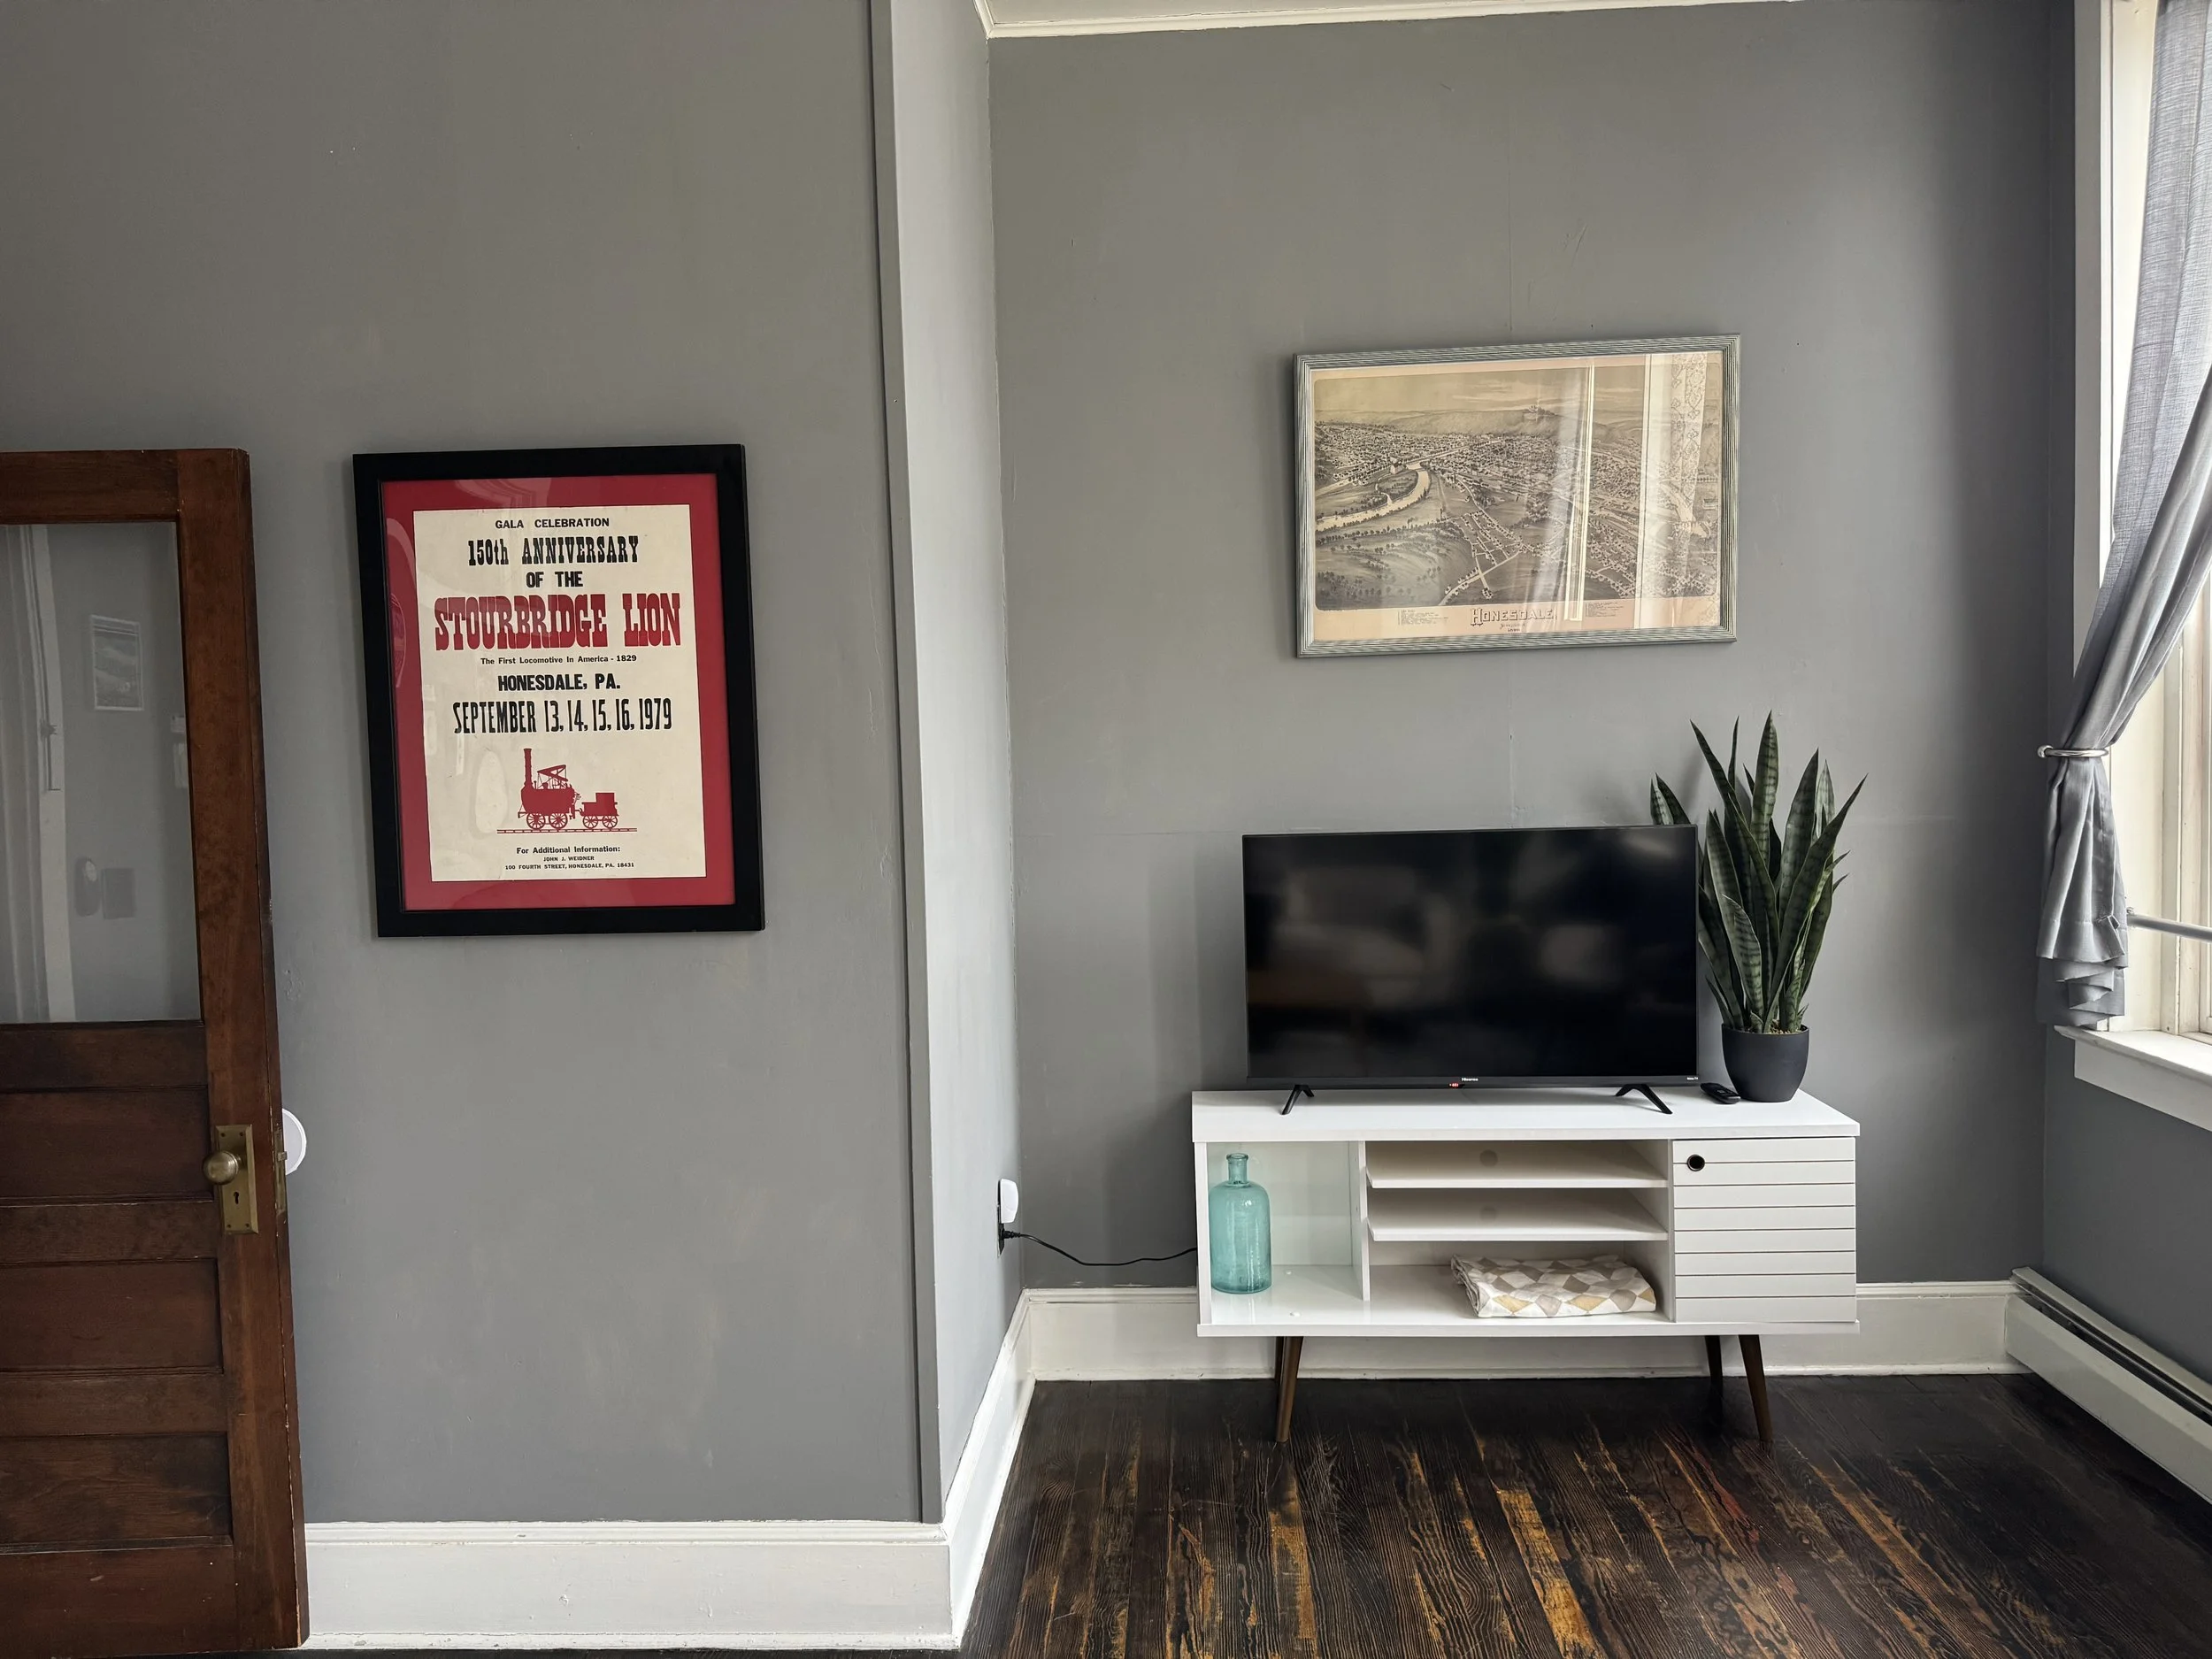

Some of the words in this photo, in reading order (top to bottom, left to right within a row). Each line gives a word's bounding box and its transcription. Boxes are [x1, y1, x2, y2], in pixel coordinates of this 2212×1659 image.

[495, 519, 524, 528] GALA
[534, 518, 610, 527] CELEBRATION
[468, 539, 509, 565] 150th
[522, 535, 639, 565] ANNIVERSARY
[526, 572, 544, 588] OF
[555, 571, 583, 587] THE
[434, 594, 608, 650] STOURBRIDGE
[623, 593, 680, 647] LION
[498, 674, 588, 691] HONESDALE,
[595, 673, 620, 689] PA.
[453, 701, 536, 733] SEPTEMBER
[544, 700, 564, 732] 13,
[567, 700, 588, 732] 14,
[592, 699, 611, 731] 15,
[616, 698, 634, 731] 16,
[639, 698, 672, 730] 1979
